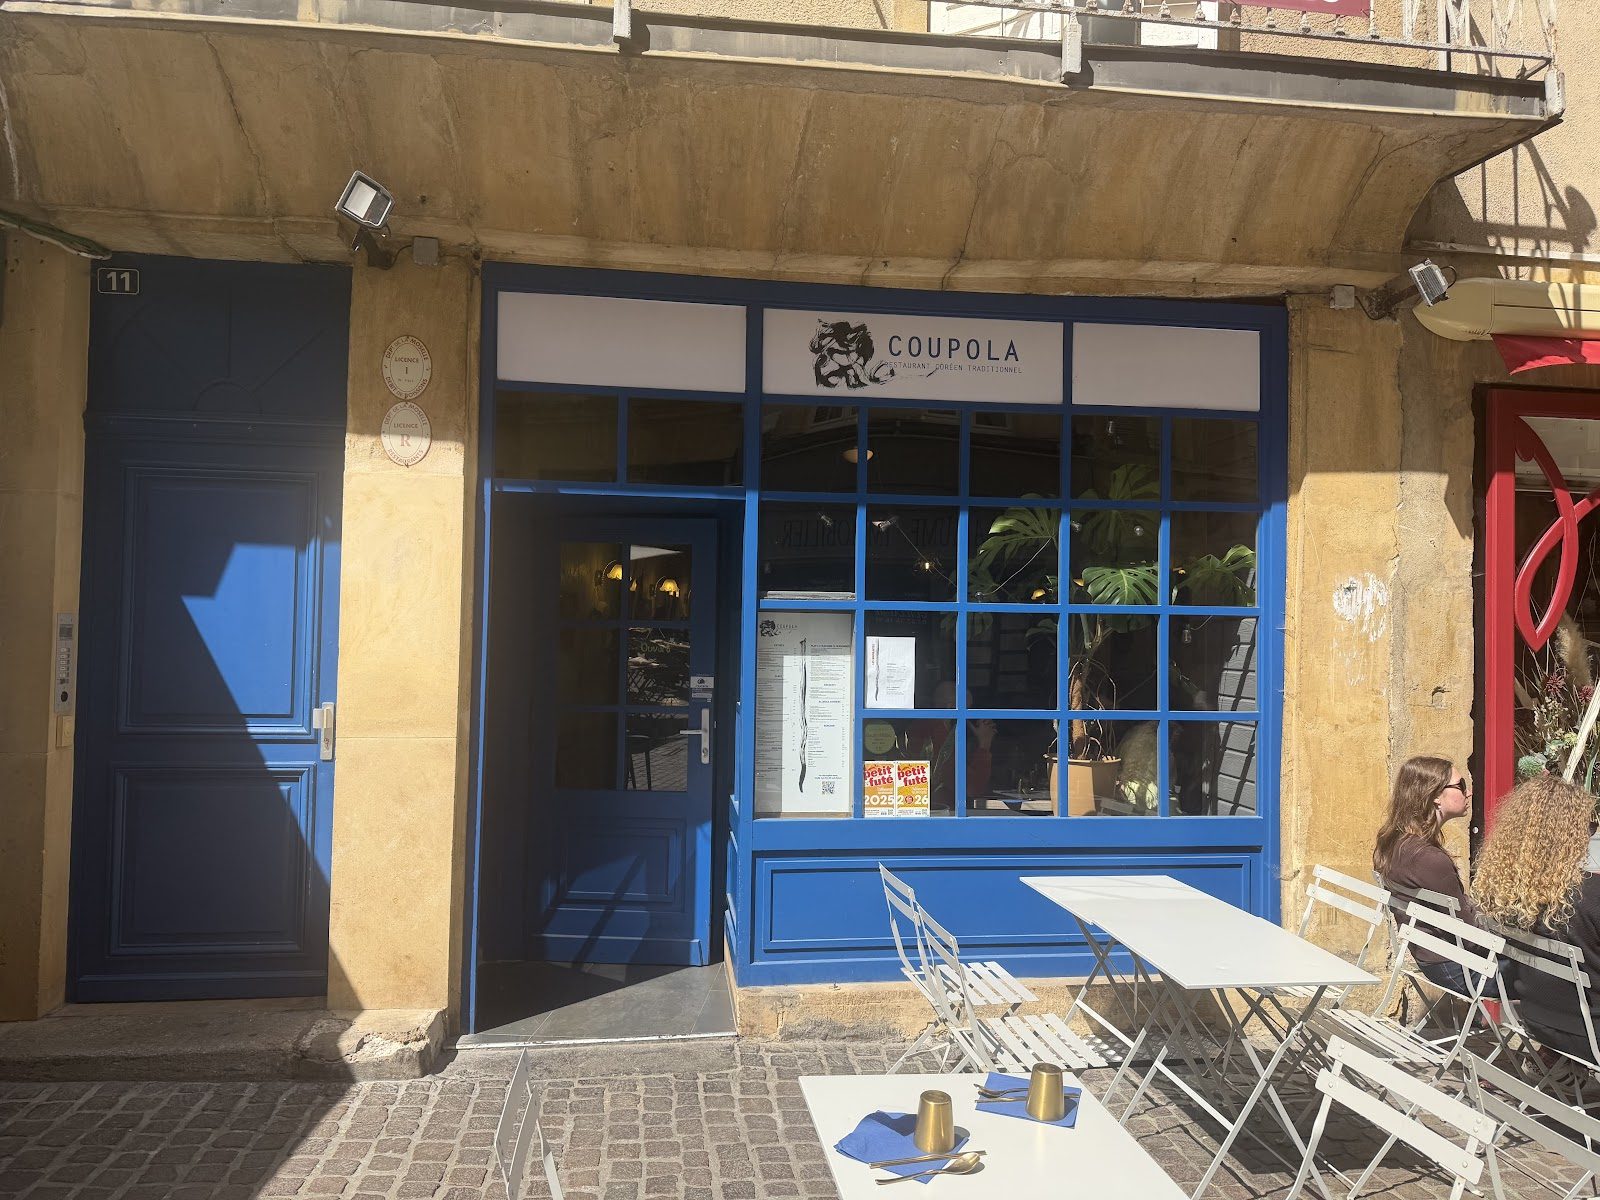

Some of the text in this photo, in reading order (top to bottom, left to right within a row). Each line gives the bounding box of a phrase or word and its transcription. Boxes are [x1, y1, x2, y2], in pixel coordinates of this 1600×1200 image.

[106, 271, 130, 292] 11
[410, 338, 429, 360] MOSELLE
[888, 335, 1019, 362] COUPOLA
[883, 361, 1022, 374] RESTAURANT CORÉEN TRADITIONNEL
[409, 403, 428, 426] MOSELLE
[400, 433, 411, 447] R
[388, 448, 424, 465] RESTAURANTS
[864, 765, 893, 781] petit
[869, 775, 894, 787] futé
[897, 765, 926, 781] petit
[902, 775, 927, 787] futé
[865, 794, 894, 805] 2025
